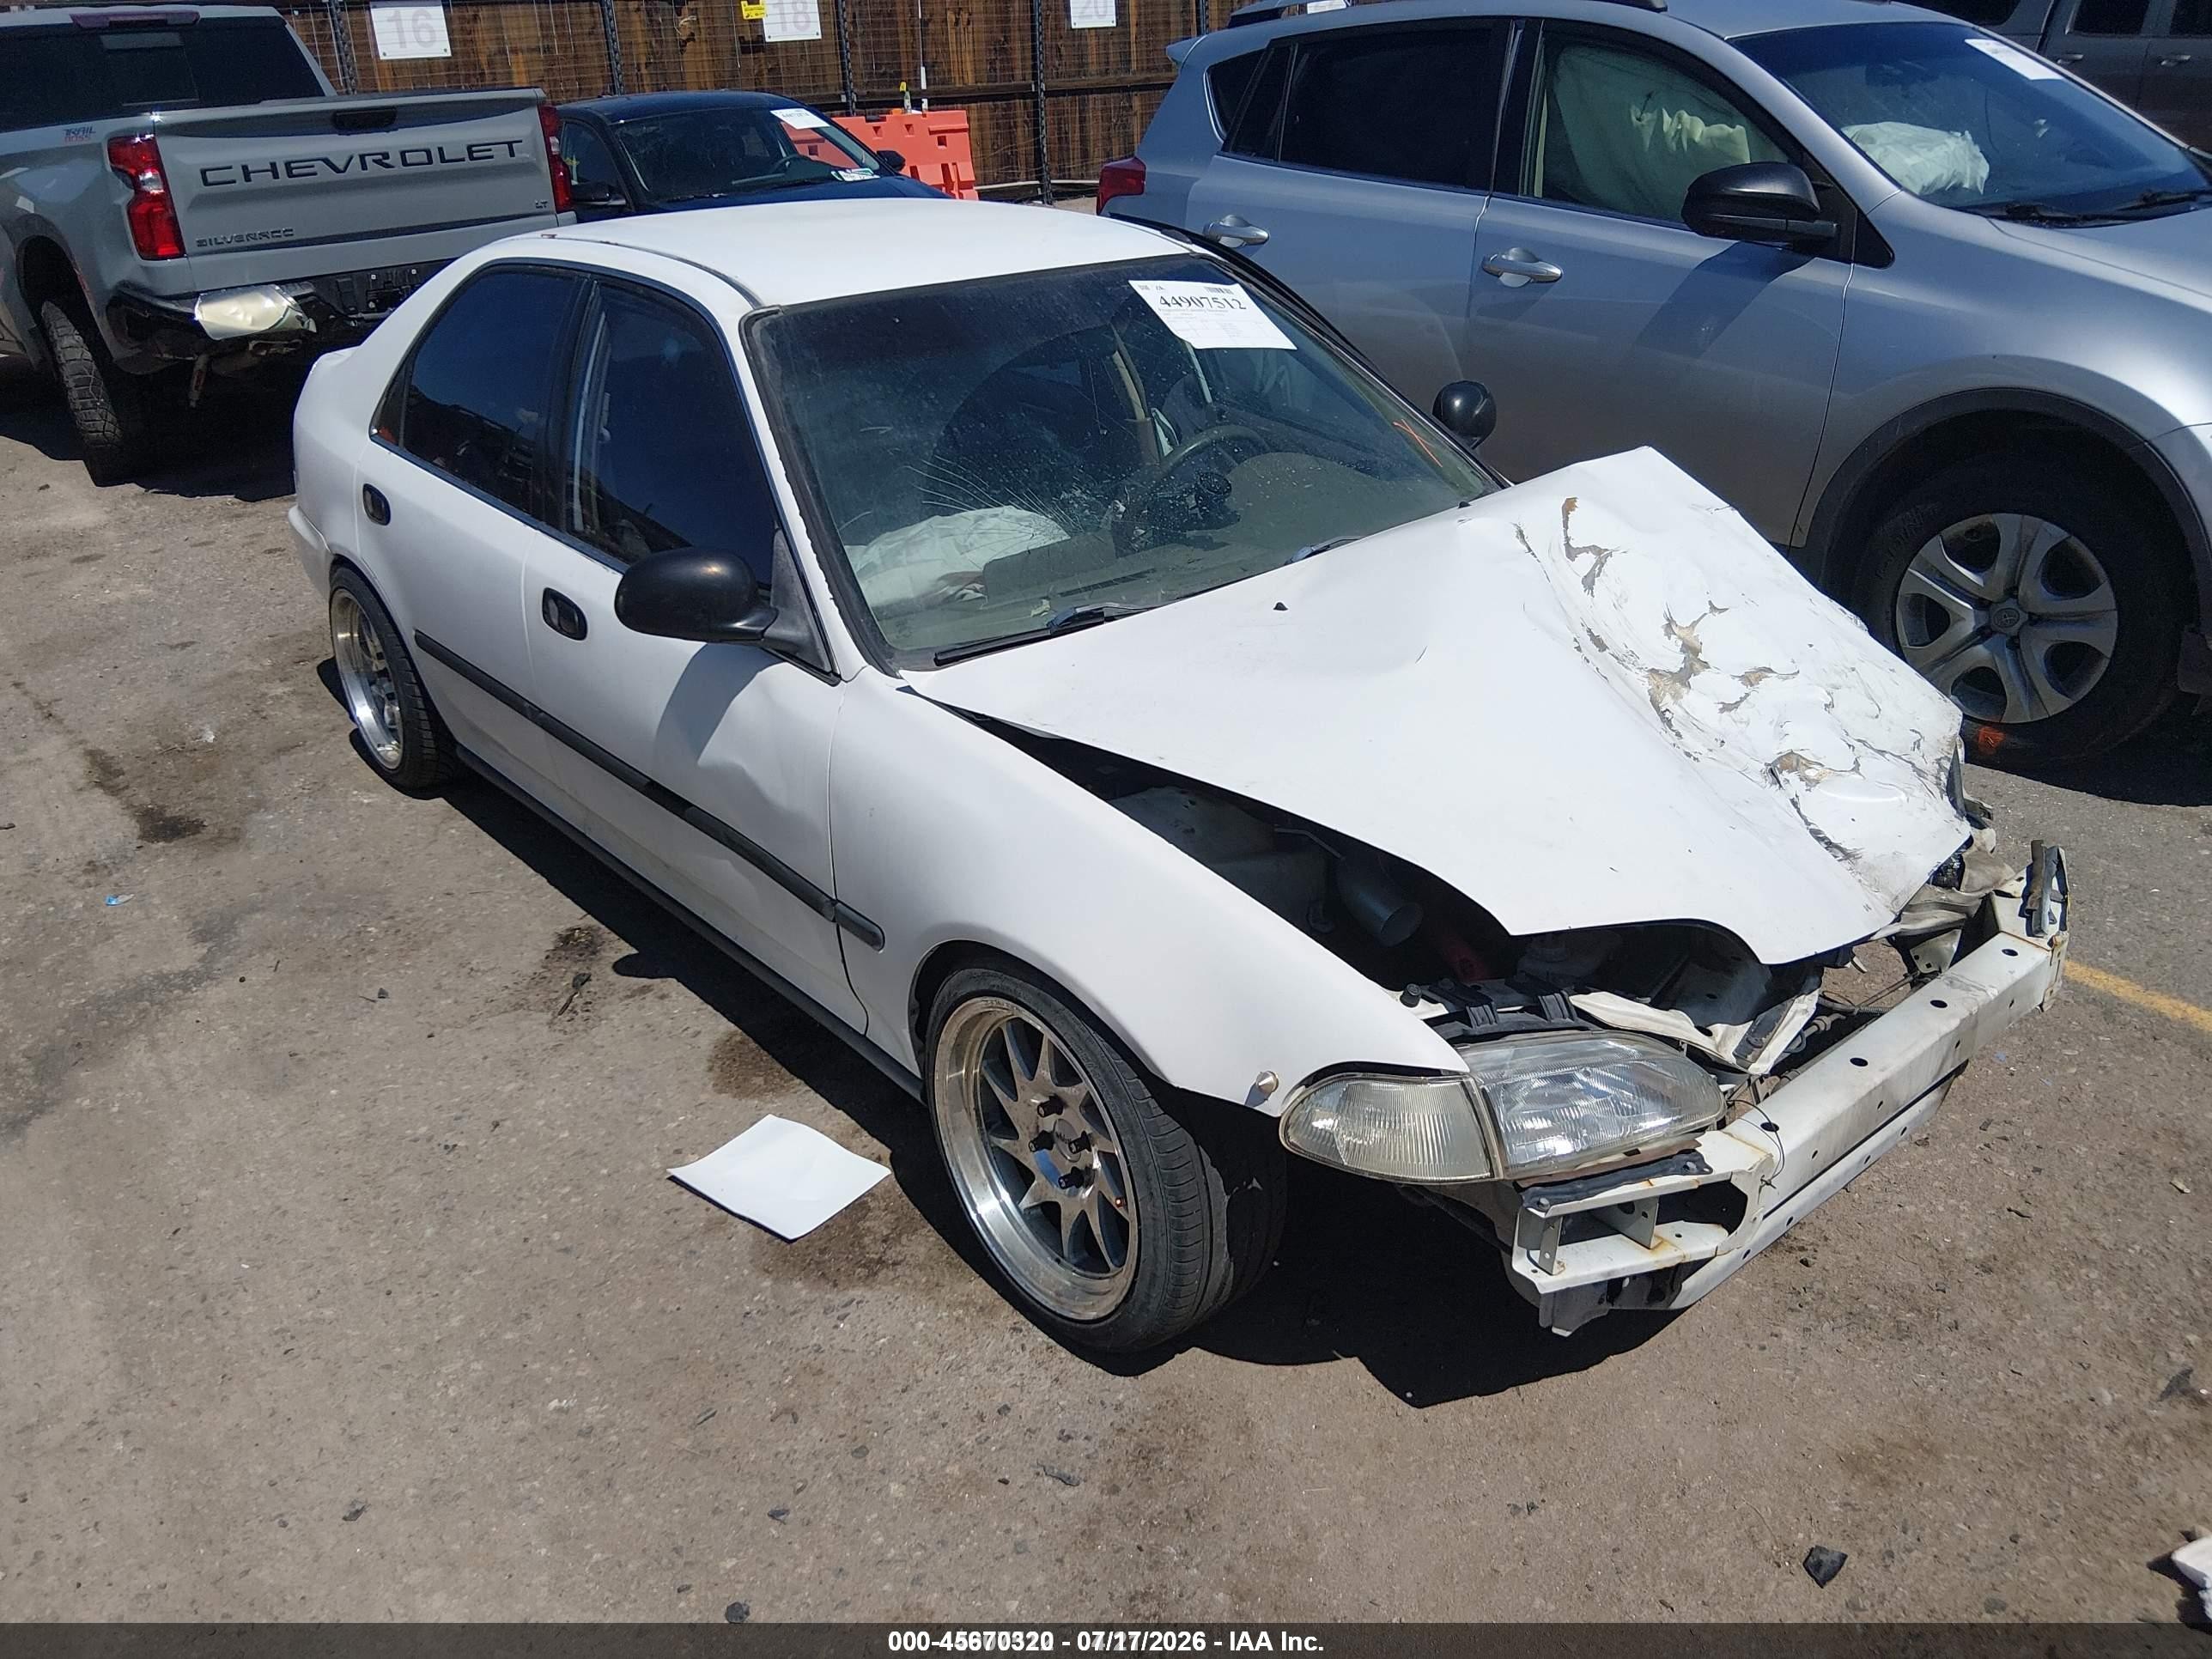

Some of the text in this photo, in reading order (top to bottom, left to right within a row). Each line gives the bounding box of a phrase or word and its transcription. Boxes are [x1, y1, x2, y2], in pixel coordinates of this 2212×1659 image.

[386, 8, 437, 49] 16
[774, 0, 811, 32] 18
[199, 139, 523, 187] CHEVROLET
[196, 228, 295, 247] SILVERADO
[1159, 295, 1248, 310] 44907512
